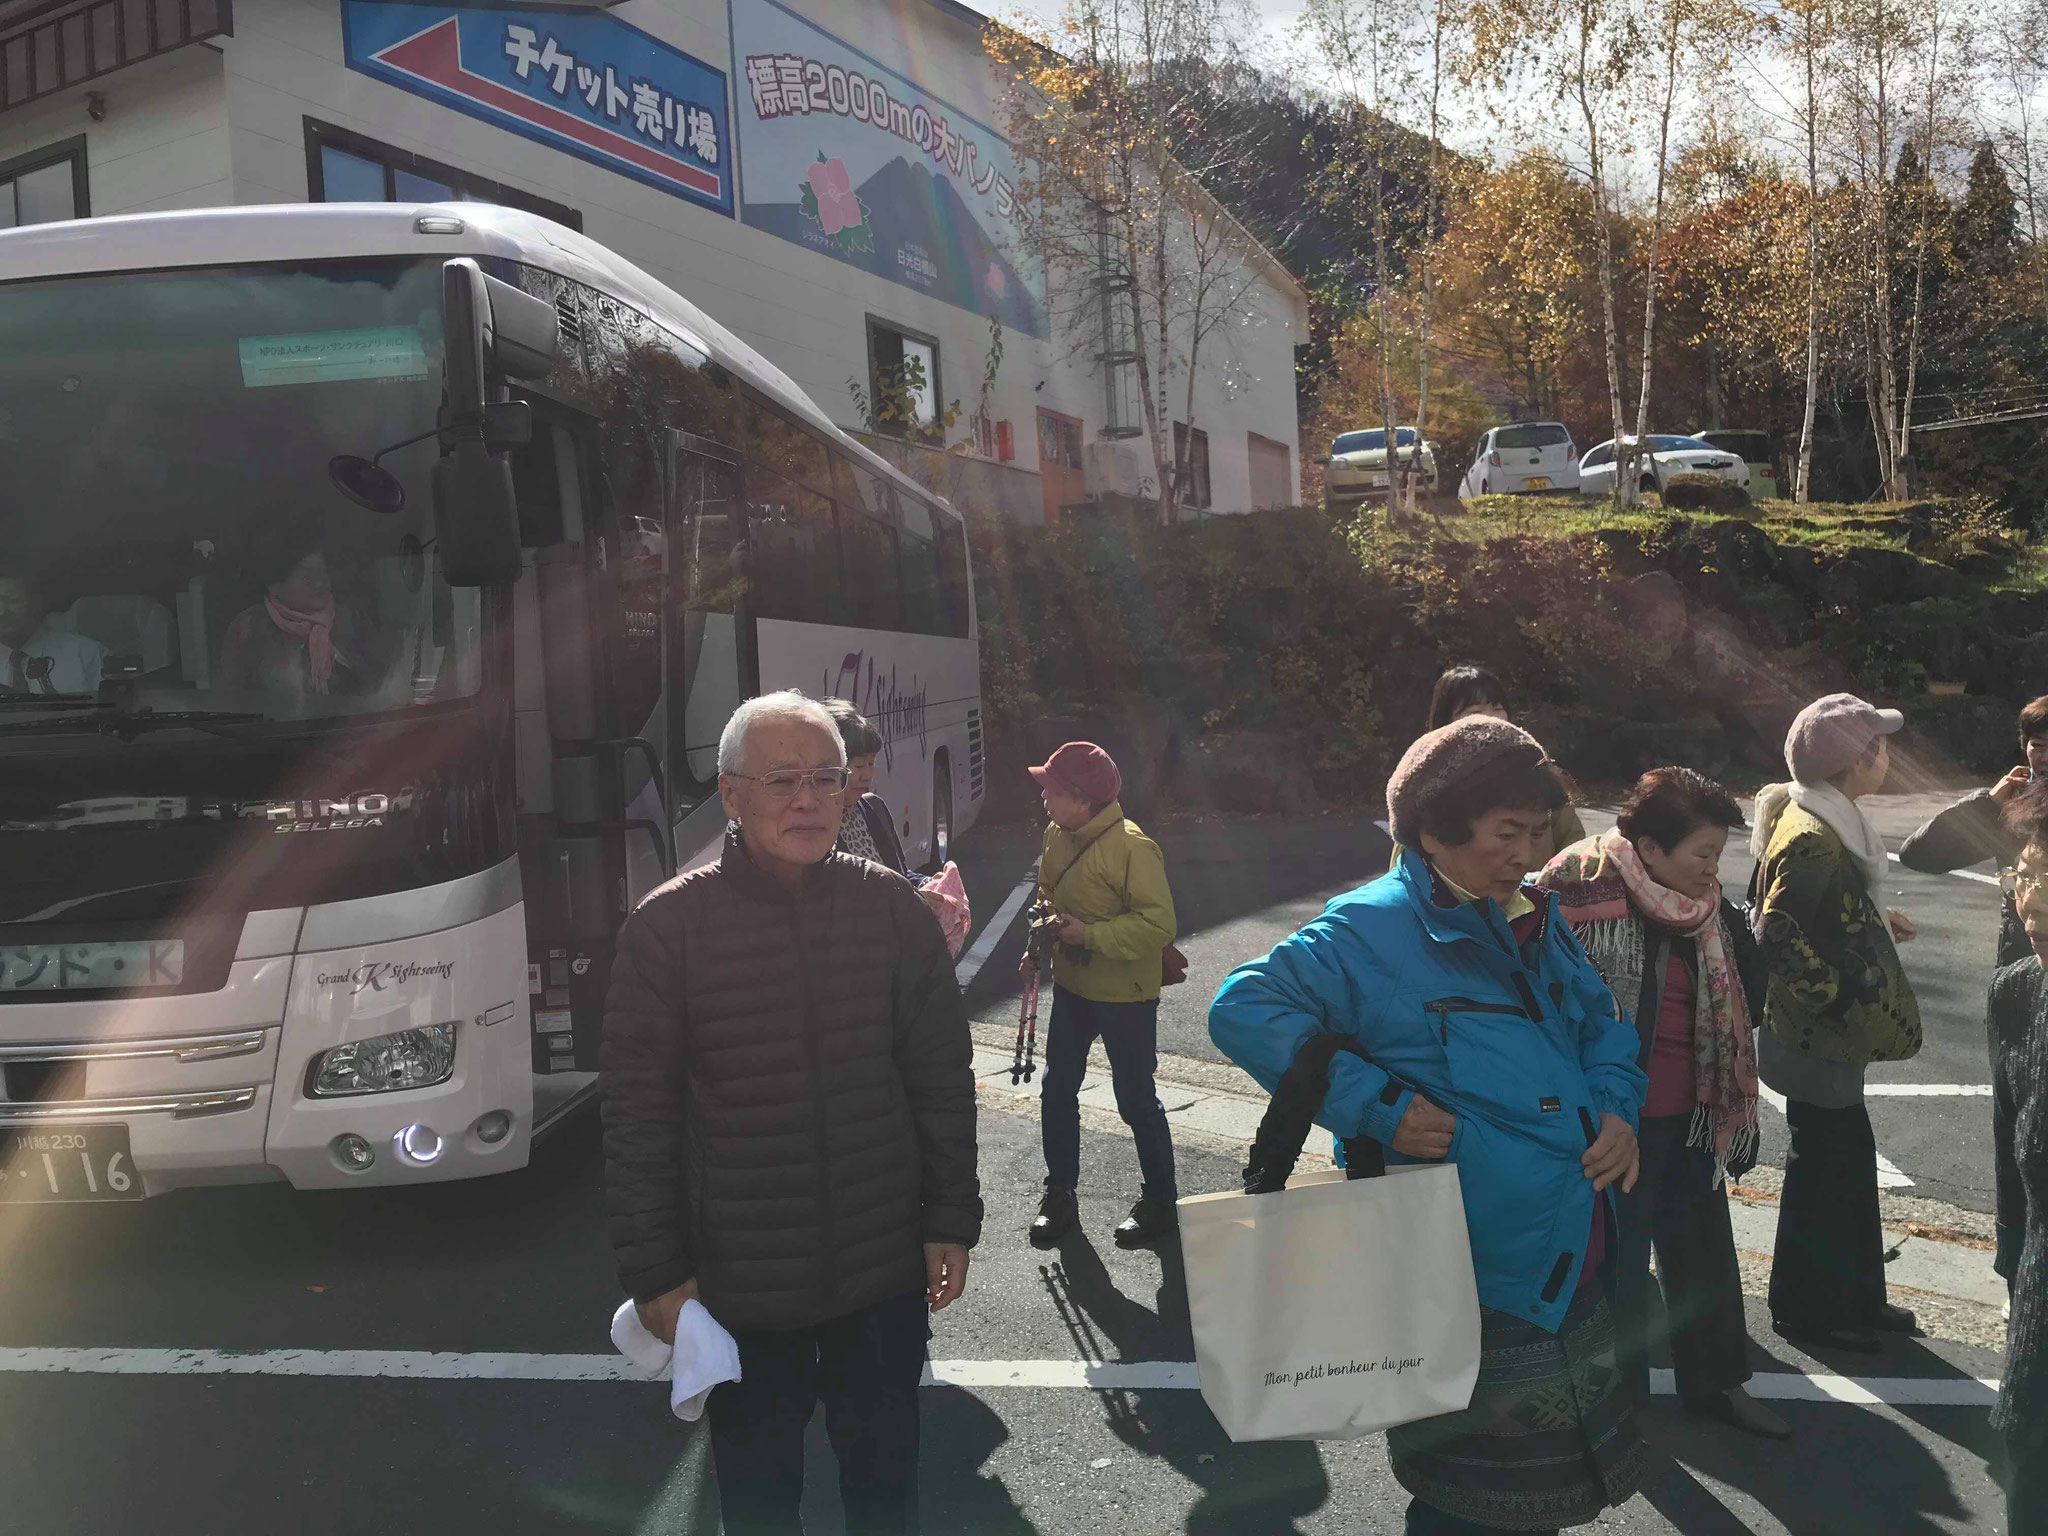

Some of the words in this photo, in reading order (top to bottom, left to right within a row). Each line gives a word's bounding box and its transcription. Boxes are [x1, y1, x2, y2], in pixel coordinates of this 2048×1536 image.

[505, 24, 717, 163] チケット売り場
[747, 54, 1034, 240] 標高2000mの大パノラマ
[266, 793, 389, 821] HINO
[274, 816, 384, 834] SELEGA
[0, 944, 179, 988] ンド・K
[317, 968, 352, 986] Grand
[348, 961, 391, 996] K
[389, 960, 456, 984] Sightseeing
[1263, 1371, 1293, 1387] Mon
[1294, 1365, 1324, 1387] petit
[1327, 1360, 1378, 1377] bonheur
[1381, 1356, 1397, 1371] du
[1395, 1356, 1425, 1375] jour
